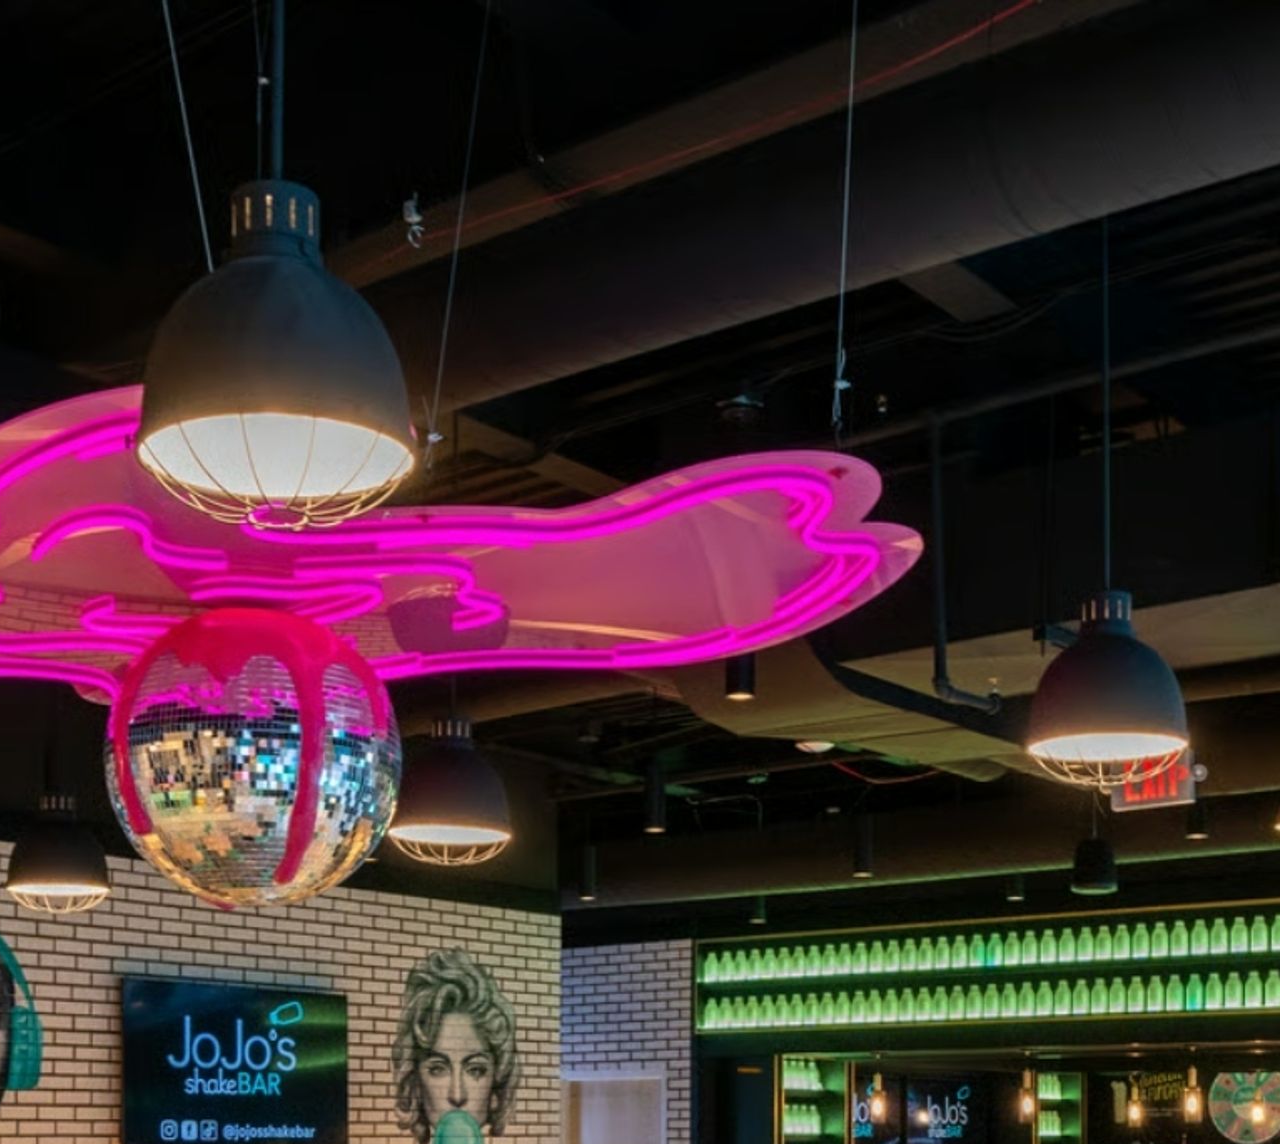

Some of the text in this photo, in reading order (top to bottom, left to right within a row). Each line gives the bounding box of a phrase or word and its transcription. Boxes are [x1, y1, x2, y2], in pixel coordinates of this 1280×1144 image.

[167, 1014, 297, 1072] JoJo's
[184, 1067, 282, 1096] shakeBAR
[223, 1124, 316, 1141] @jojosshakebar
